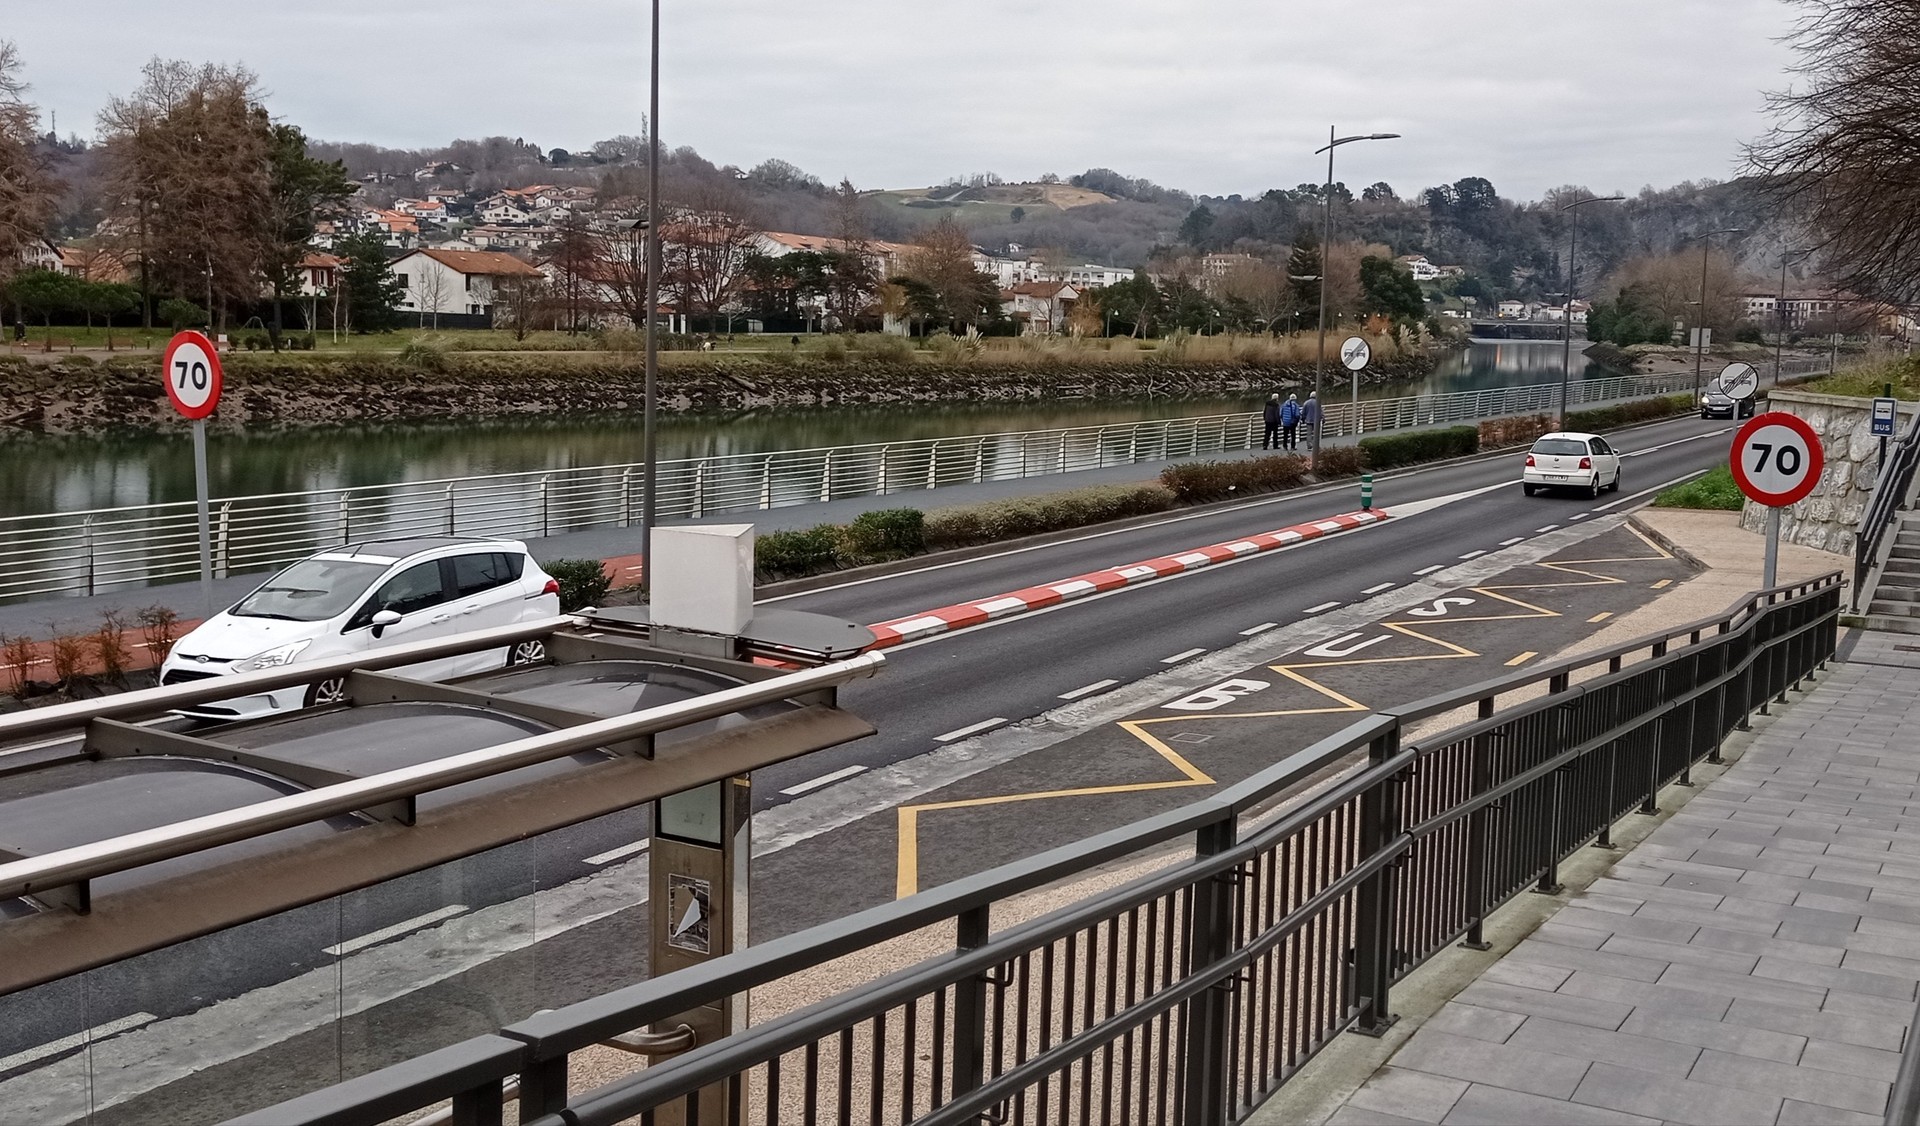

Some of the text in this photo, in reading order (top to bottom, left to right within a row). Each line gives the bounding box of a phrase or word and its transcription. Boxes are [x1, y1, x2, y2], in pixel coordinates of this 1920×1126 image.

[175, 361, 207, 390] 70
[1751, 443, 1801, 476] 70
[1160, 597, 1477, 710] BUS
